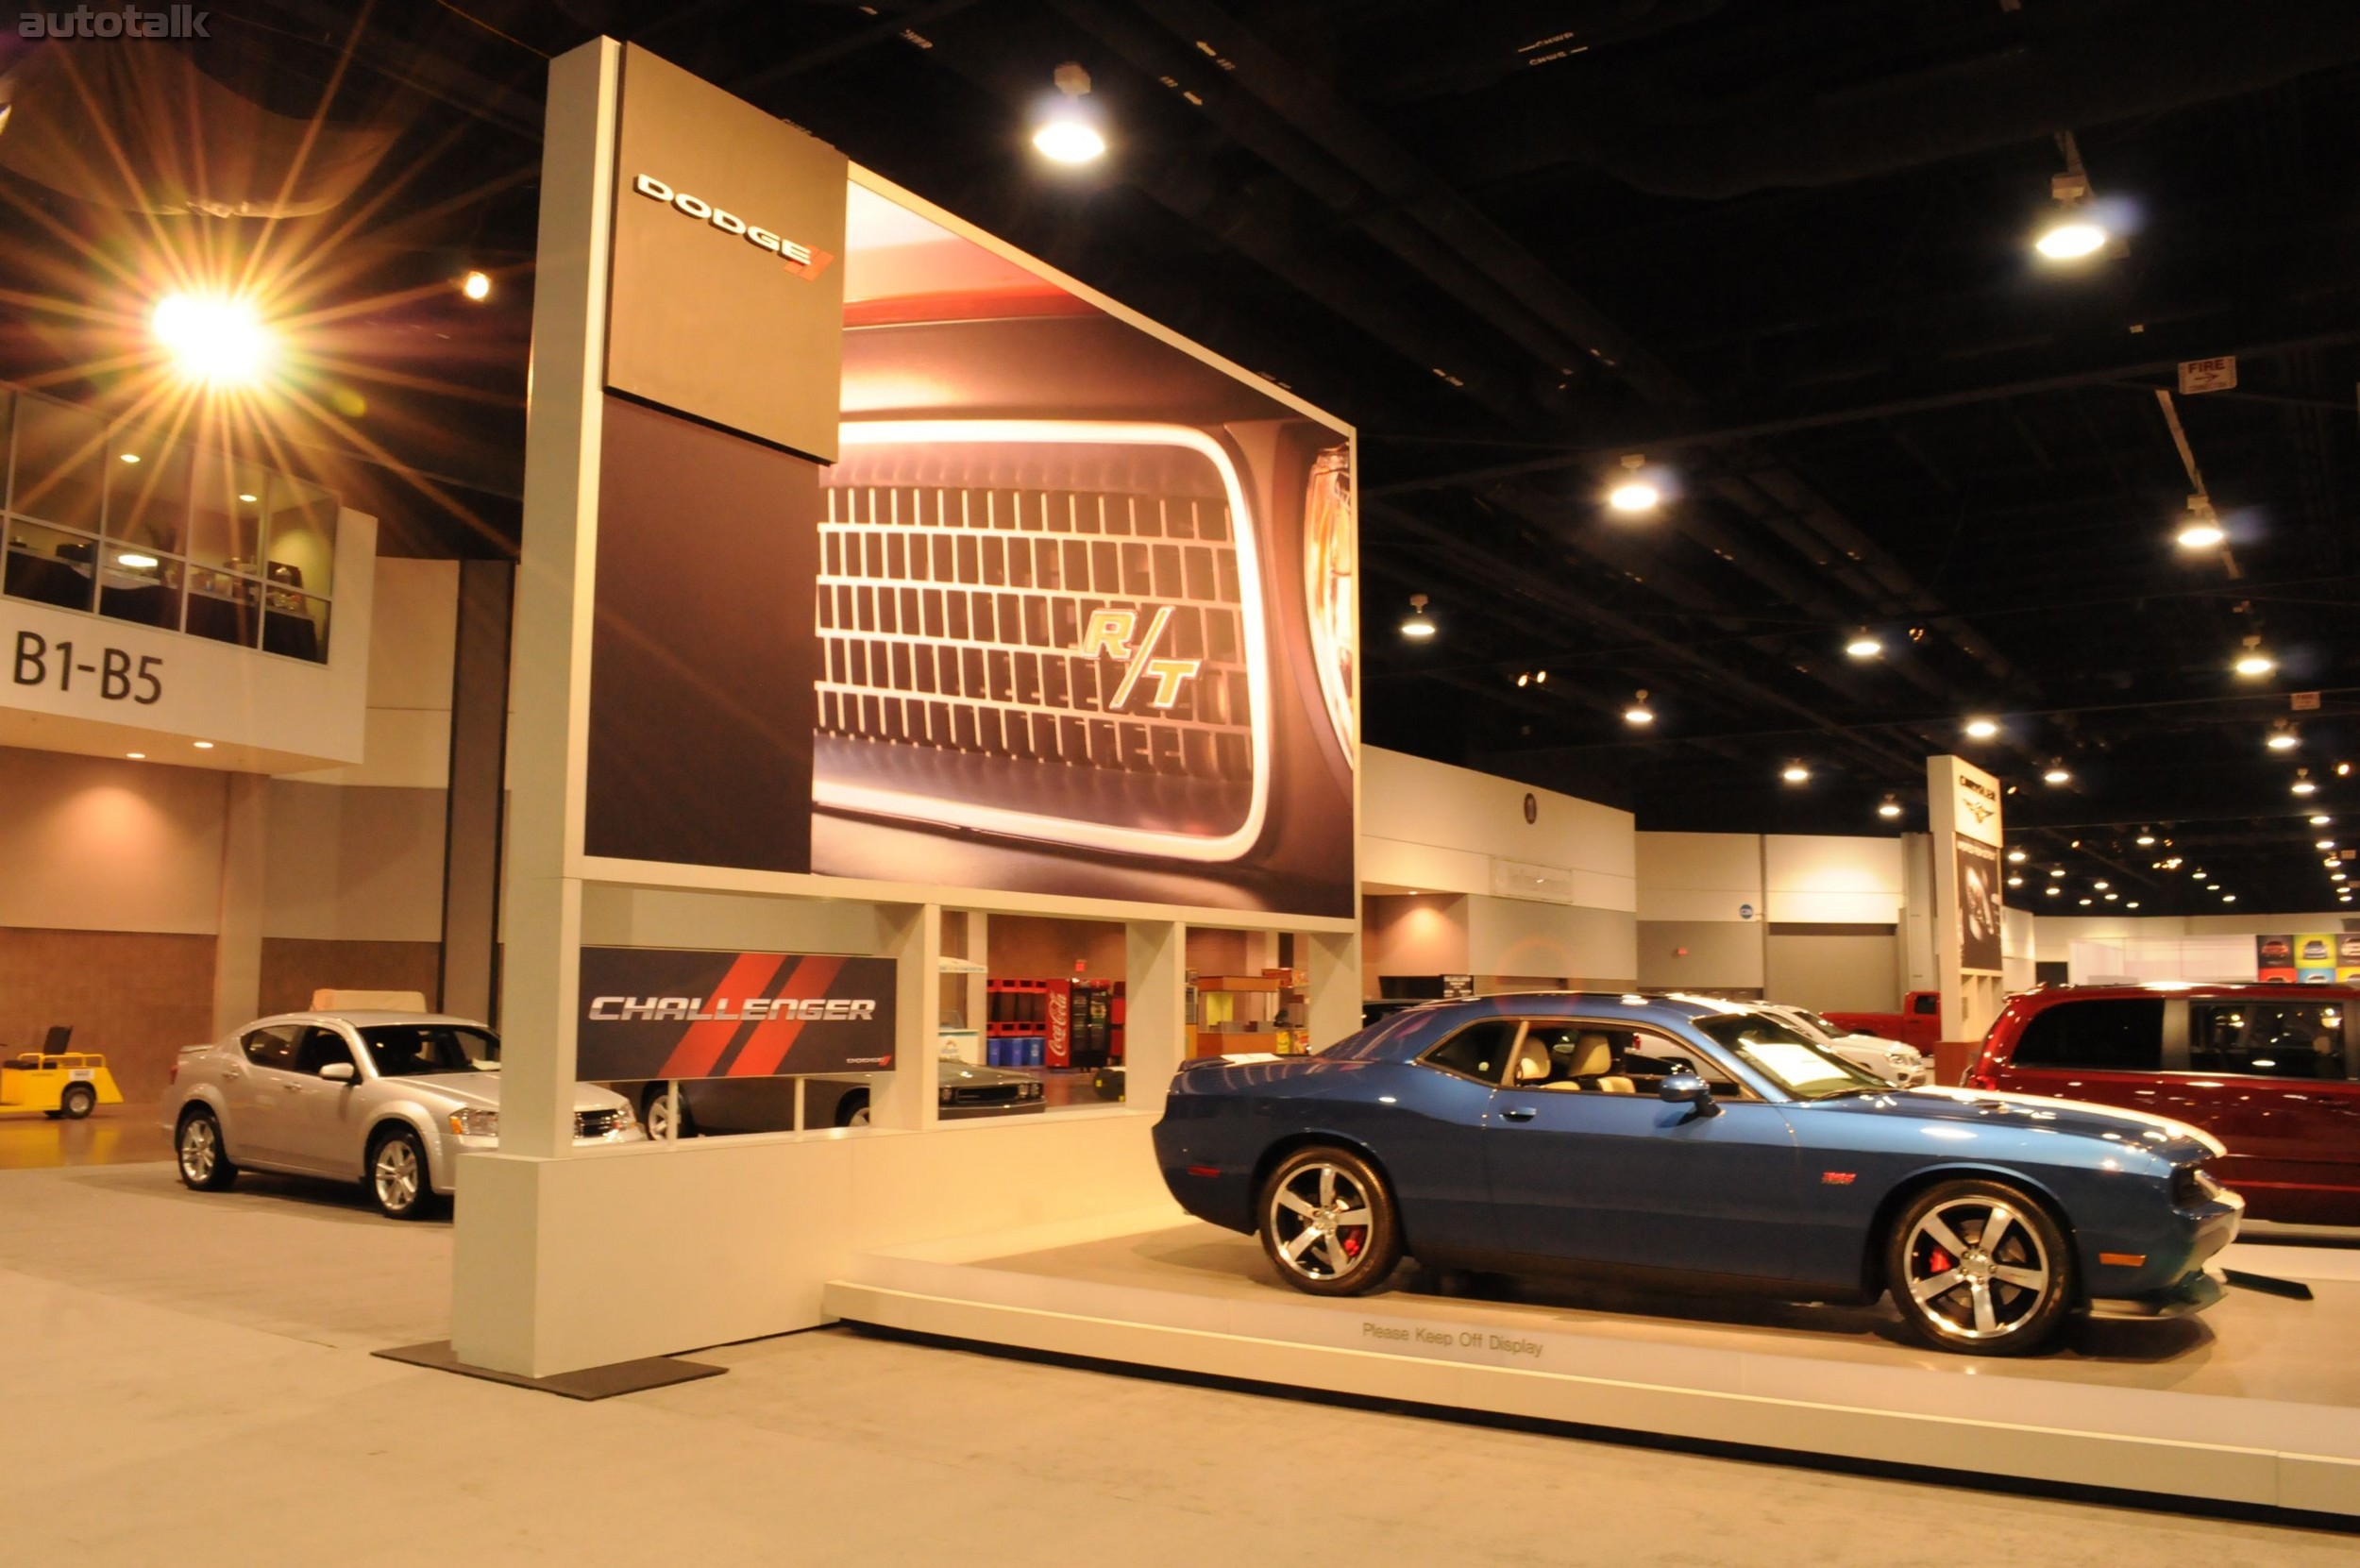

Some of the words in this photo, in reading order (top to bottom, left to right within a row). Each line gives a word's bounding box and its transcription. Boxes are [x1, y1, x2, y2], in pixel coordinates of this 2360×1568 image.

[635, 173, 812, 265] DODGE
[2188, 359, 2225, 374] FIRE
[14, 631, 162, 704] B1-B5
[1082, 606, 1201, 710] R/T
[588, 996, 876, 1020] CHALLENGER
[1362, 1322, 1409, 1341] Please
[1415, 1327, 1454, 1347] Keep
[1458, 1332, 1483, 1348] Off
[1489, 1335, 1543, 1357] Display
